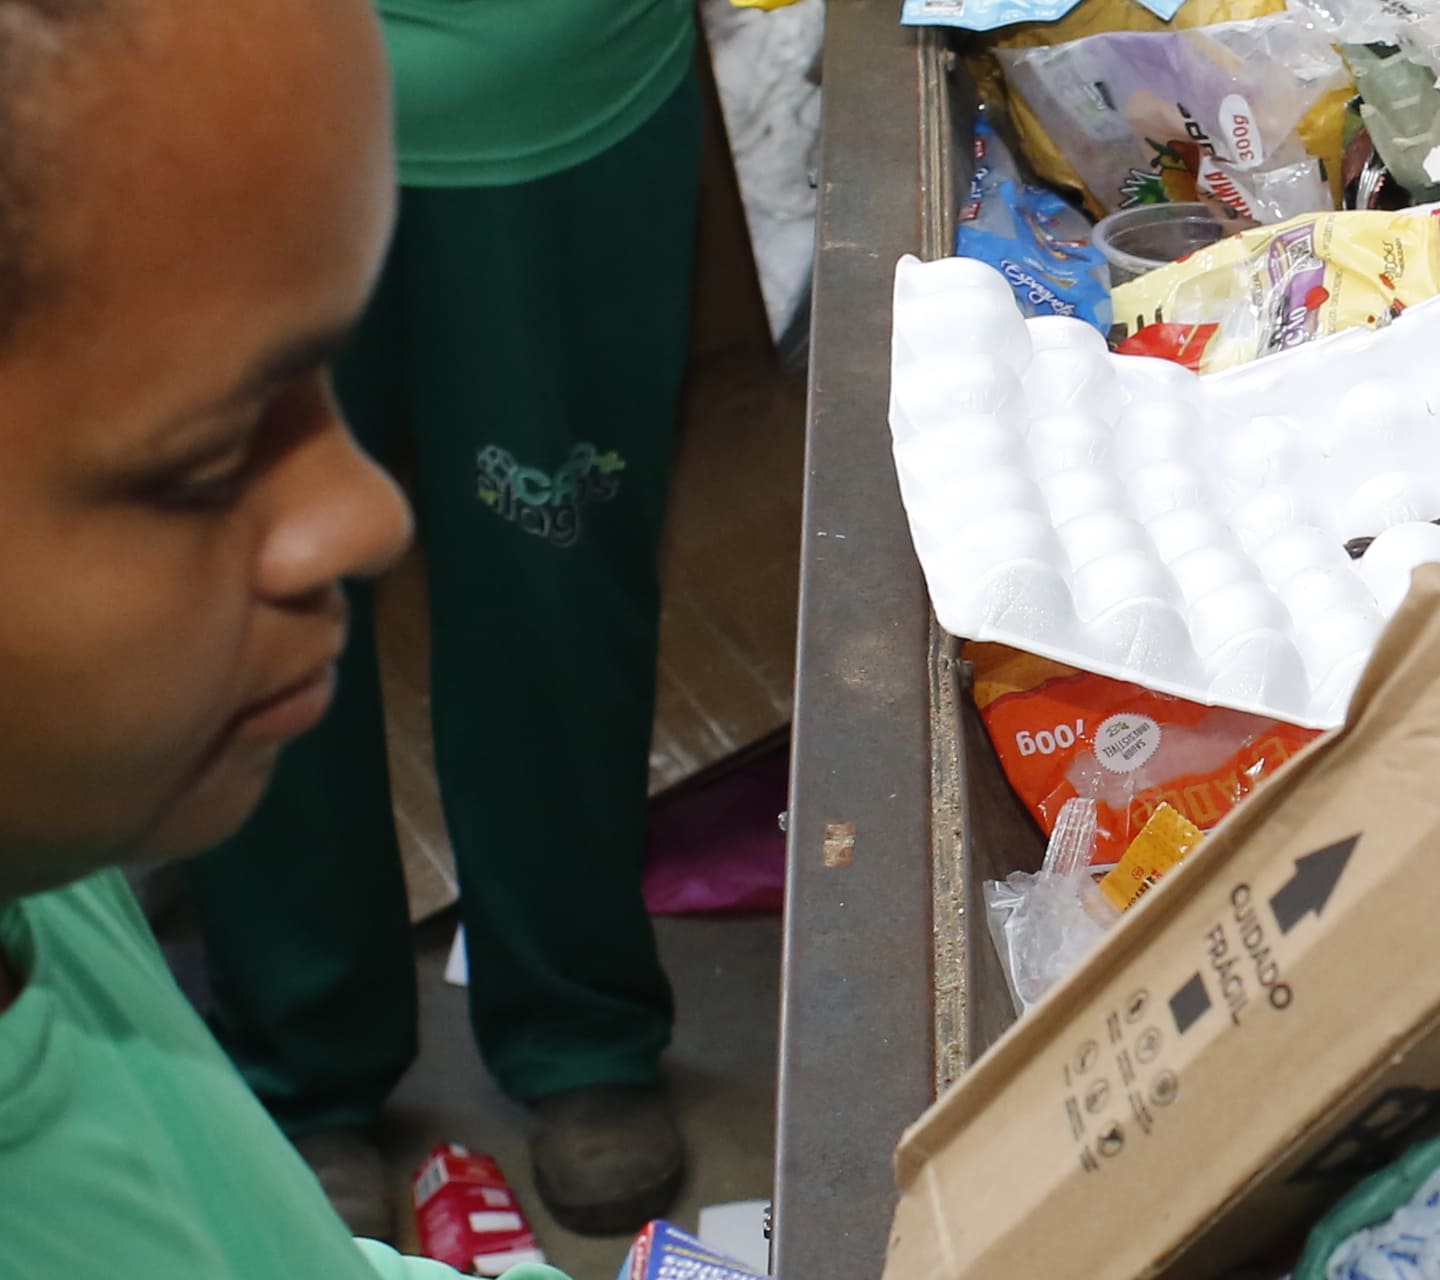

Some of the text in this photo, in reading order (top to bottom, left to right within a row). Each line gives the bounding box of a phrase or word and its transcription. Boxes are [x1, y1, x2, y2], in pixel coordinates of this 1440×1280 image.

[1233, 114, 1256, 162] 300g
[1205, 923, 1250, 1027] FRÁGIL
[1231, 883, 1292, 1010] CUIDADO
